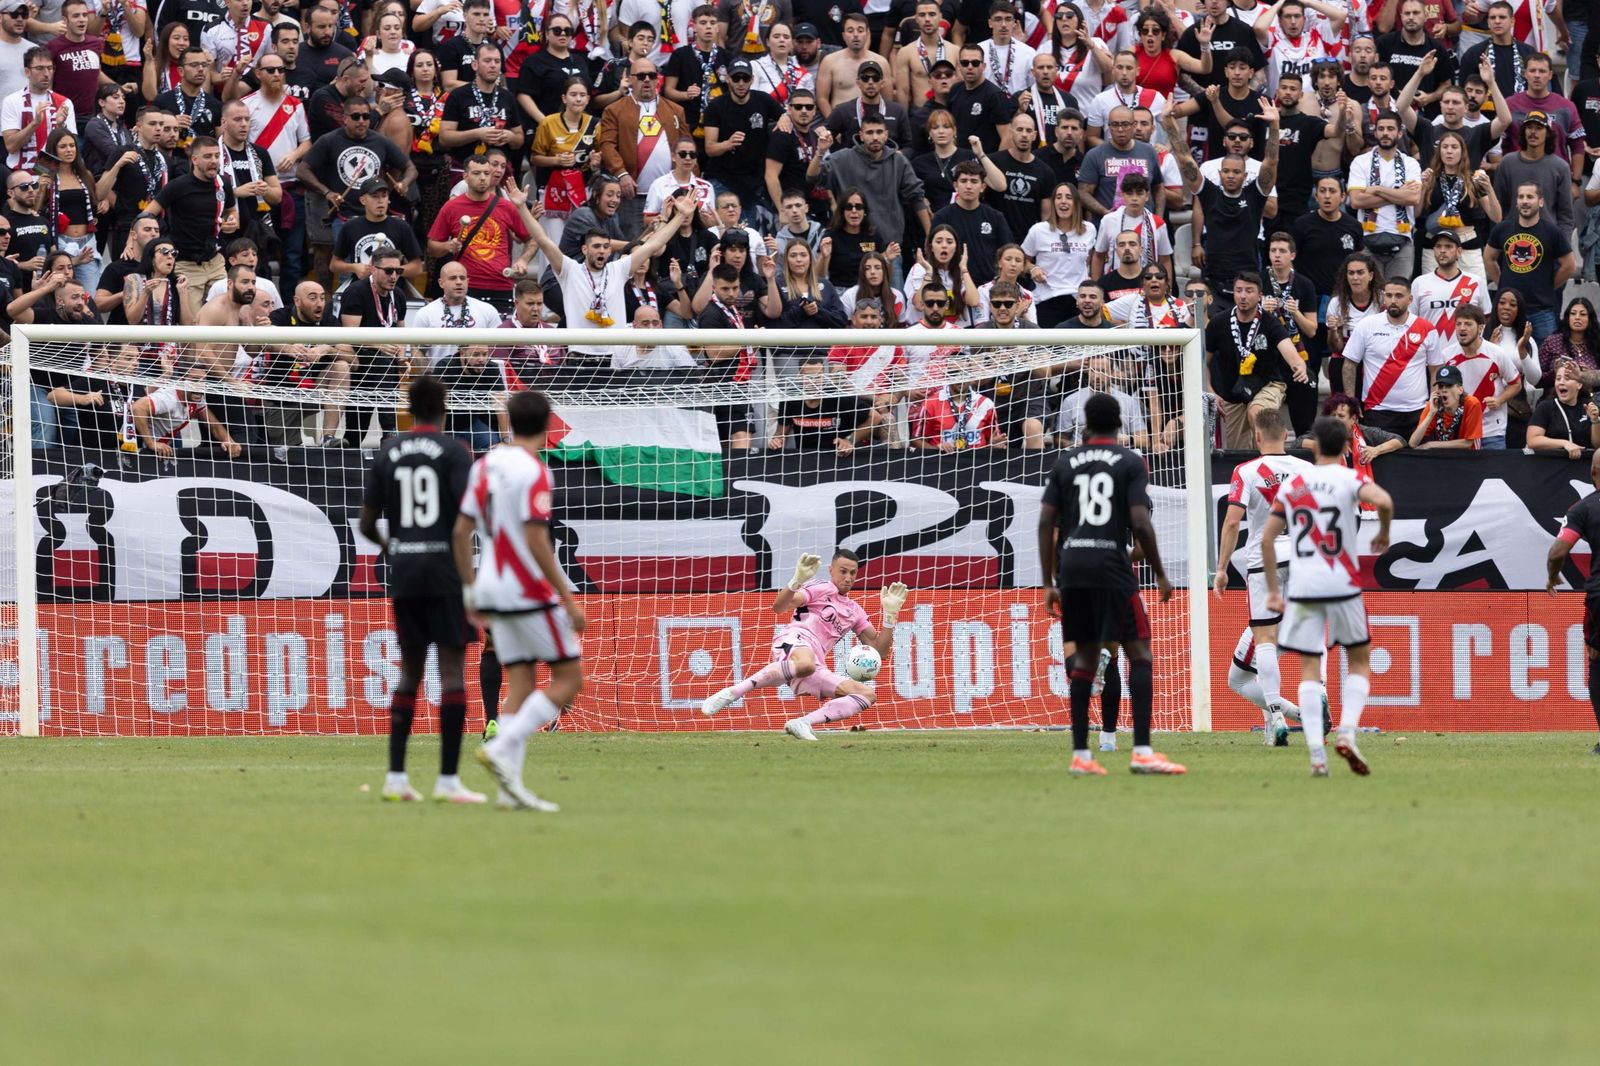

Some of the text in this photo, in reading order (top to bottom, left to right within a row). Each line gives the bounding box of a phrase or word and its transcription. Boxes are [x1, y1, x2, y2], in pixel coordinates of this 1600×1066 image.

[394, 465, 440, 528] 19
[1074, 472, 1114, 526] 18
[1291, 506, 1344, 558] 23
